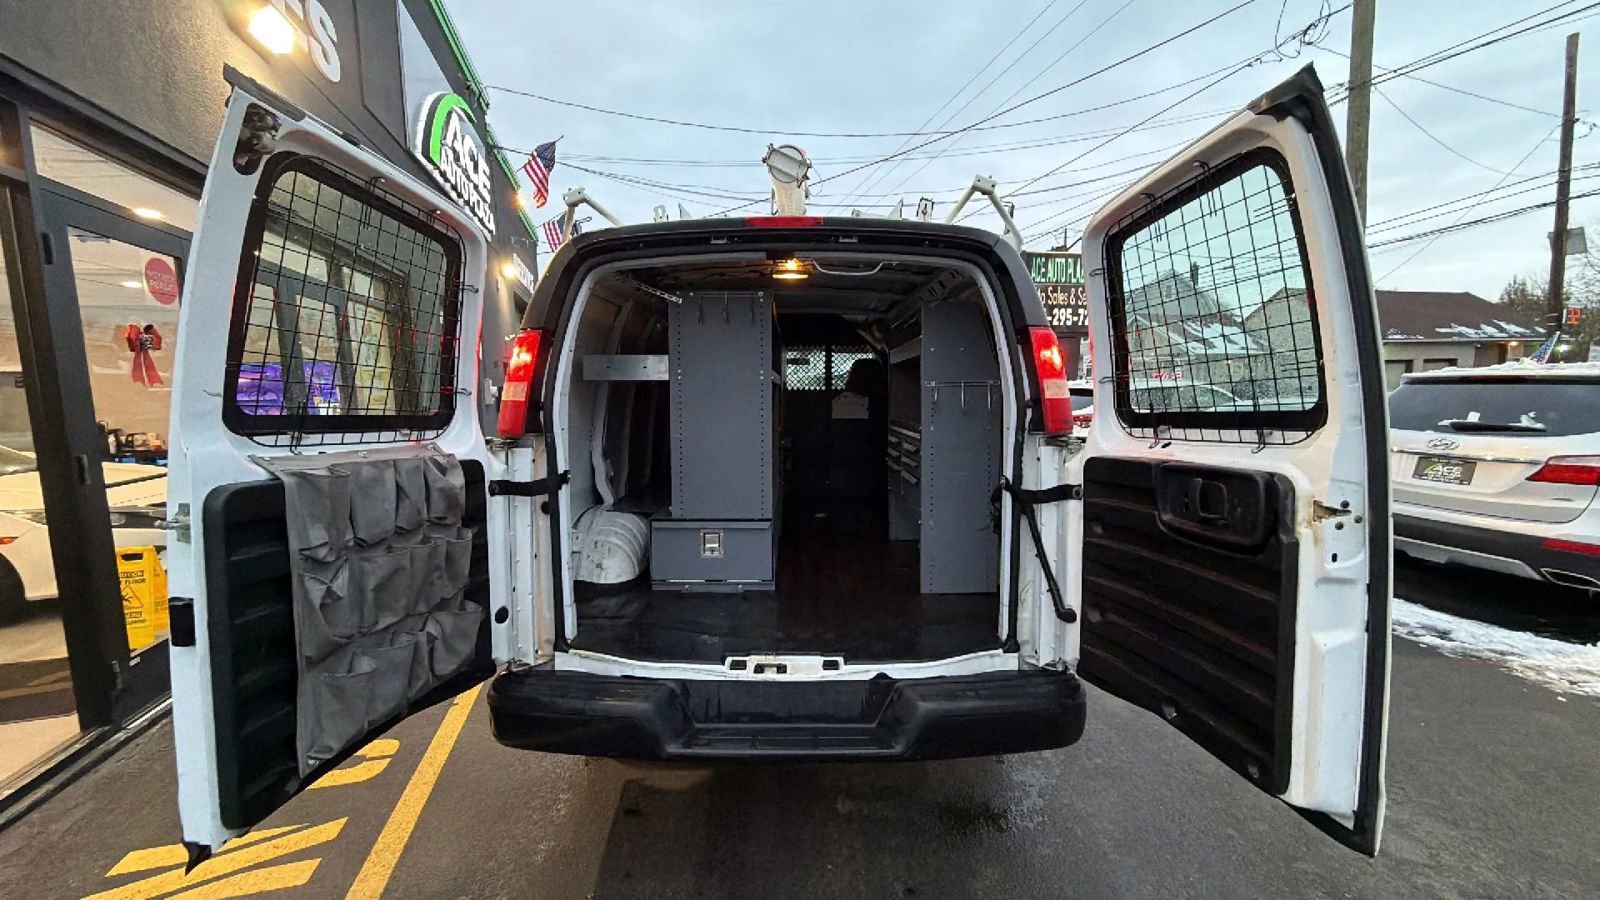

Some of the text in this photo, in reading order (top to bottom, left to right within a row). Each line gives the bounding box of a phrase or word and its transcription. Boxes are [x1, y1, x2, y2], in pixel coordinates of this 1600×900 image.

[446, 107, 491, 204] ACE
[440, 147, 496, 236] AUTO PLAZA
[1031, 257, 1046, 282] ACE
[1047, 257, 1065, 282] AUTO
[1047, 286, 1069, 305] Sales
[1069, 287, 1076, 305] &
